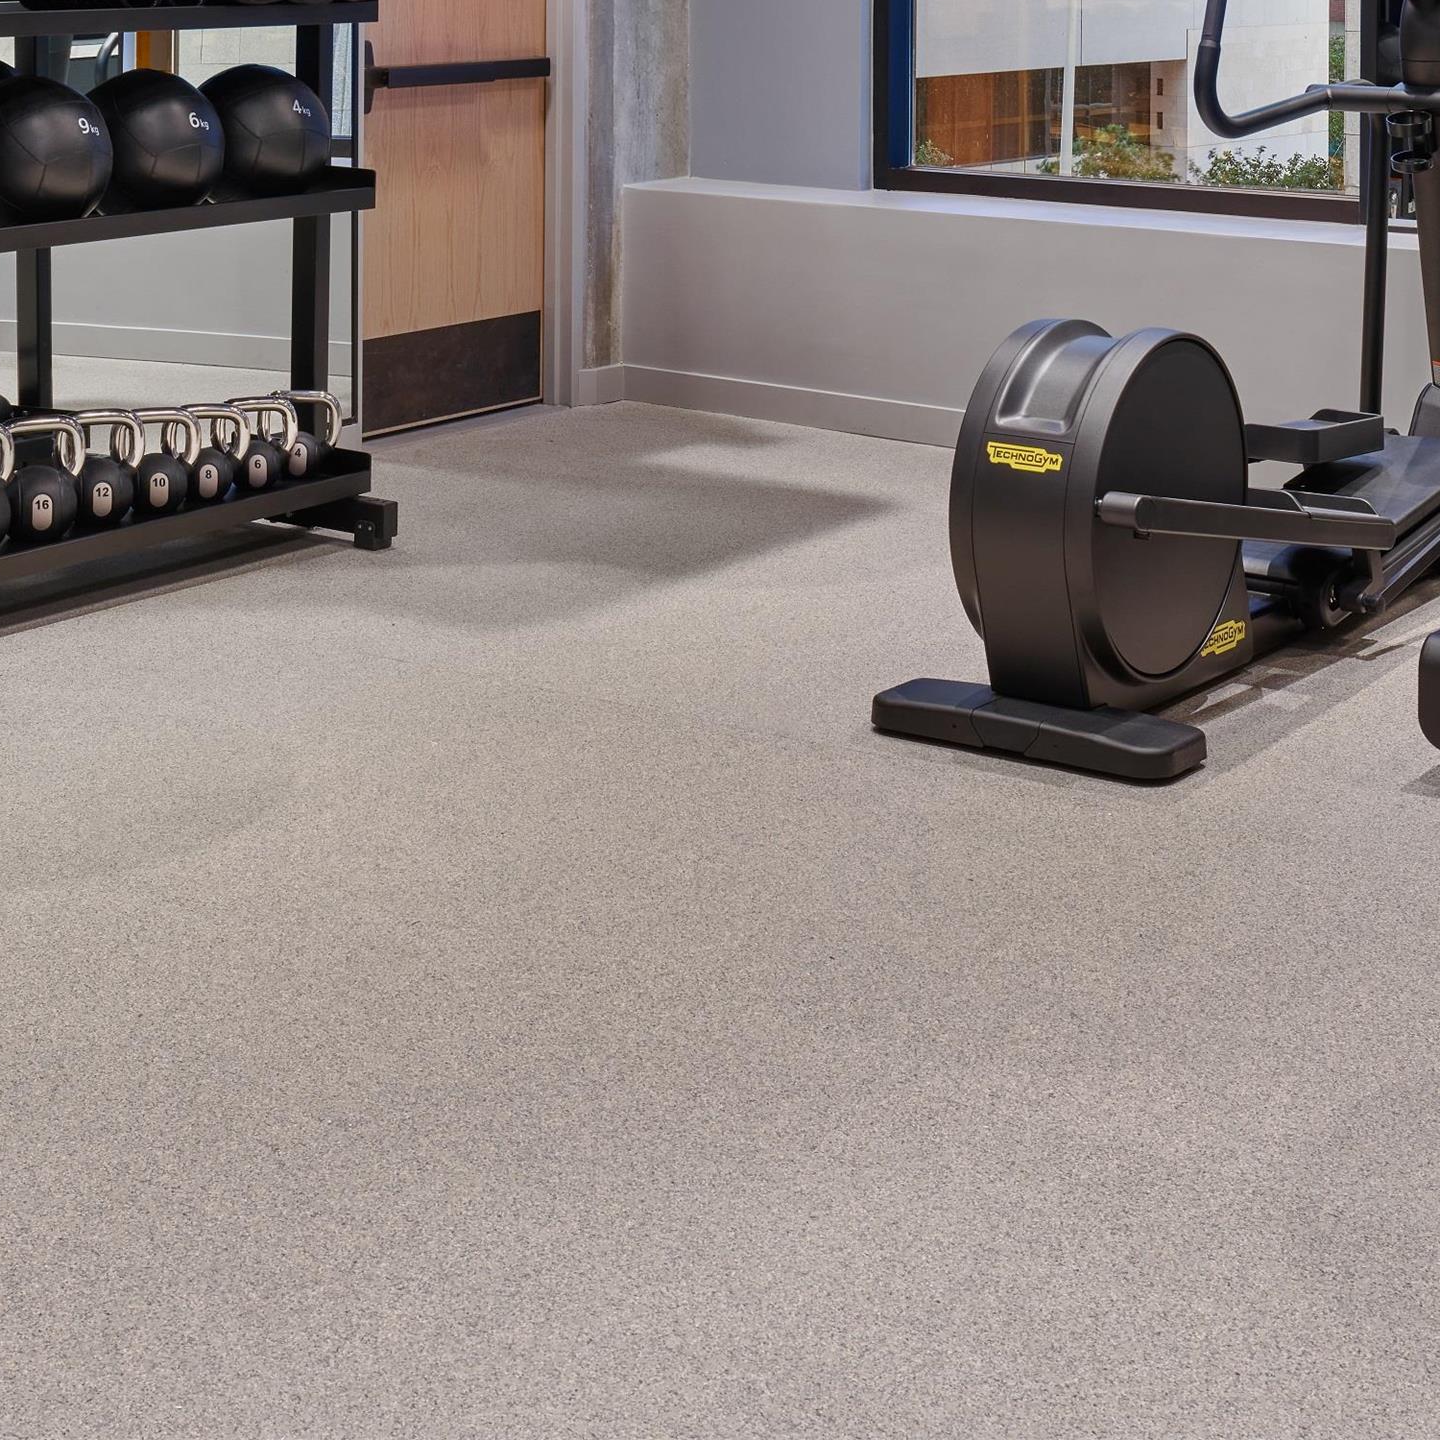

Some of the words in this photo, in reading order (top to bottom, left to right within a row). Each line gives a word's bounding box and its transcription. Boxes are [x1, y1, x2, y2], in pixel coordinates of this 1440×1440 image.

[294, 448, 301, 458] 4
[990, 445, 1059, 467] TECHNOGYM
[254, 459, 261, 469] 6
[205, 469, 212, 479] 8
[152, 477, 166, 488] 10
[95, 487, 109, 498] 12
[35, 500, 49, 511] 16
[1204, 624, 1243, 650] CHNOGYM
